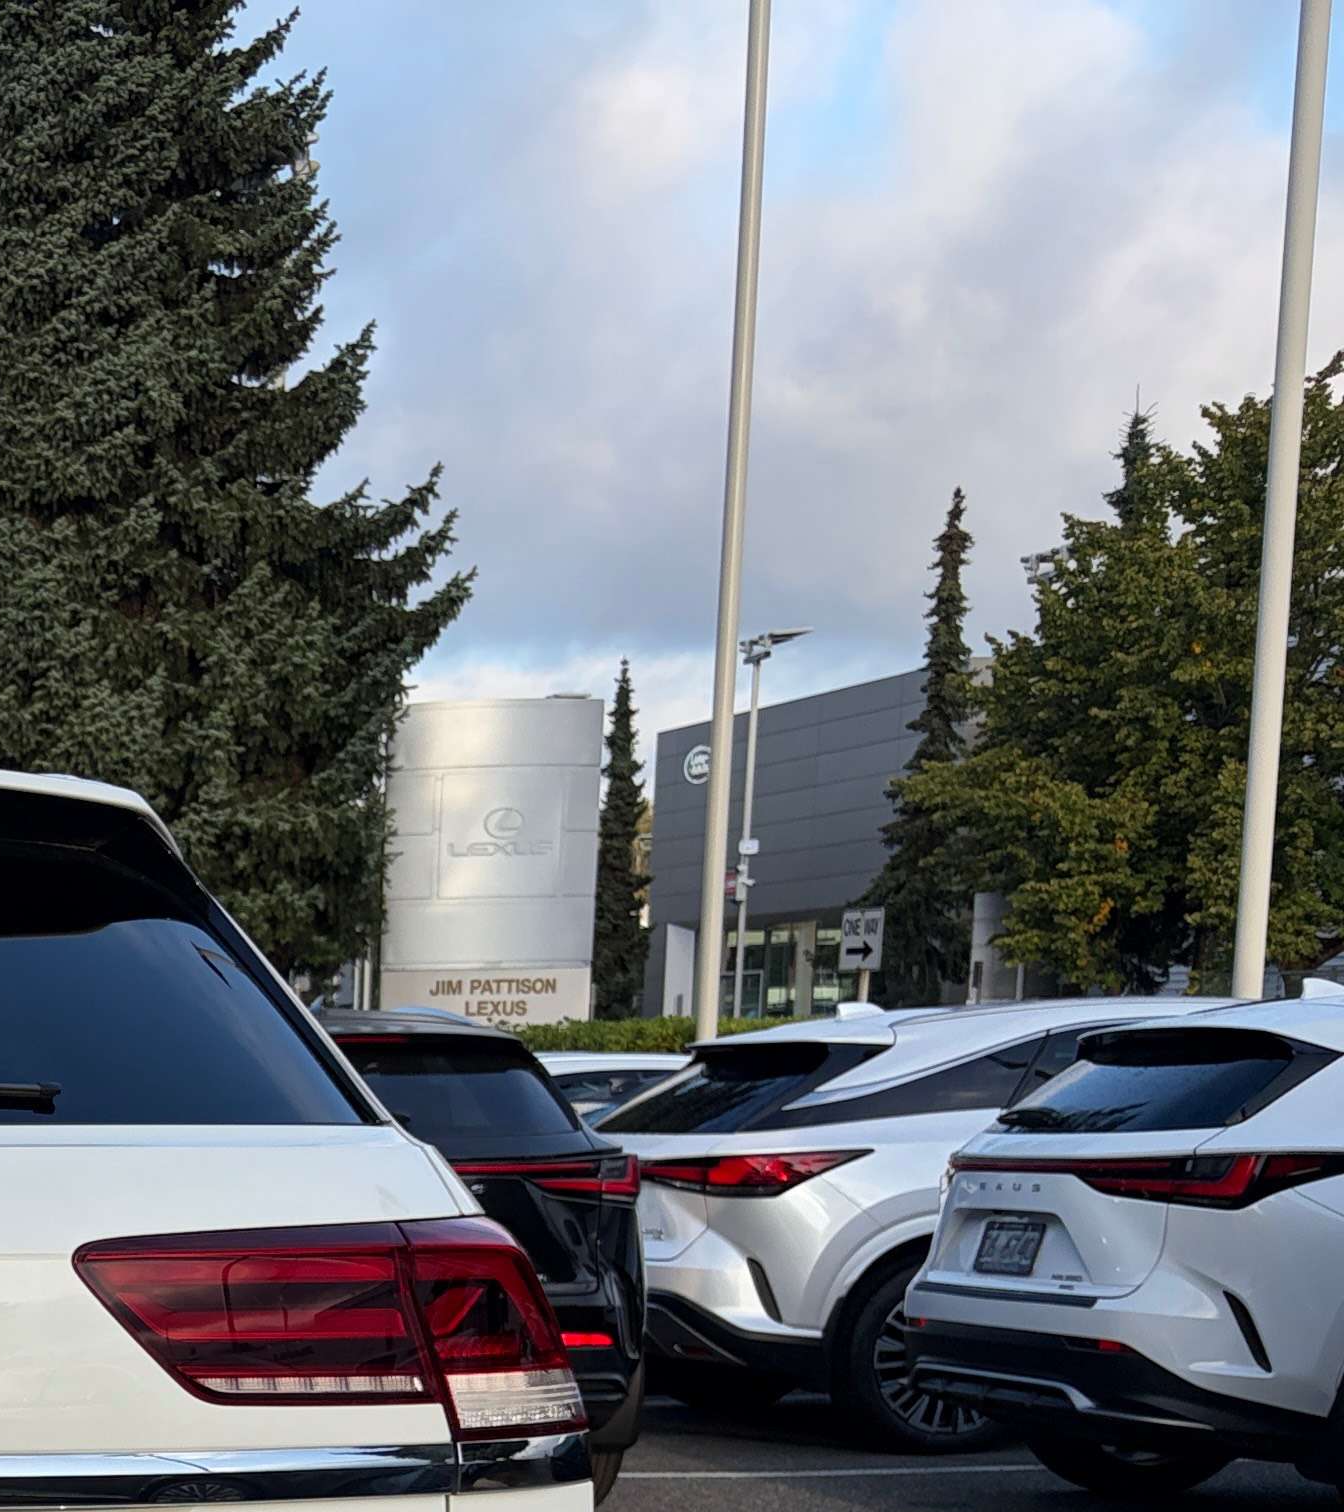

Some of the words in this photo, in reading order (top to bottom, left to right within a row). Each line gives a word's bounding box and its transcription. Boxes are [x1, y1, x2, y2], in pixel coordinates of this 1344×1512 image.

[446, 841, 554, 858] LEXUS
[843, 917, 861, 937] ONE
[863, 917, 879, 937] WAY
[429, 979, 462, 996] JIM
[468, 977, 558, 996] PATTISON
[464, 999, 528, 1017] LEXUS
